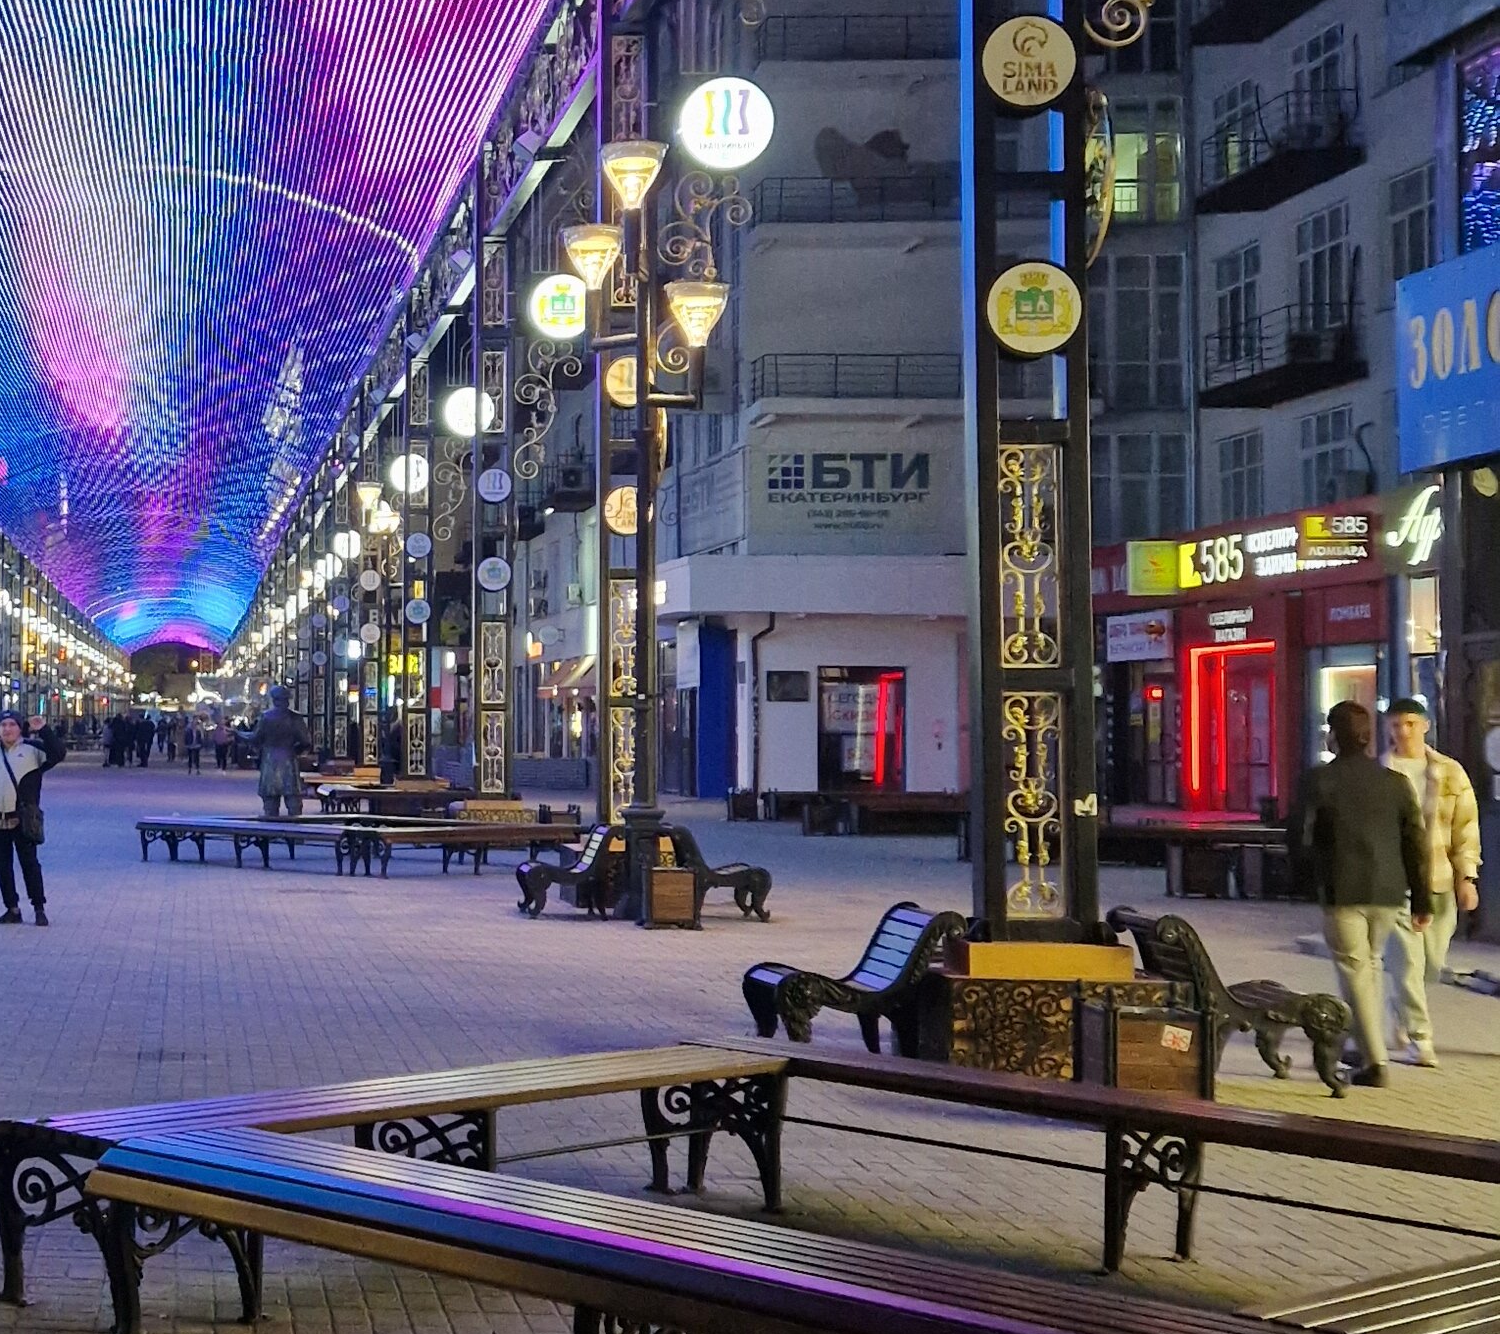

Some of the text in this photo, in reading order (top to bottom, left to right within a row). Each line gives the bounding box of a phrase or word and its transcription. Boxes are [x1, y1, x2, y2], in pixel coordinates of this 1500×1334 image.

[1003, 61, 1058, 79] SIMA
[1002, 78, 1059, 95] LAND
[811, 452, 931, 490] БТИ
[767, 491, 931, 504] ЕКАТЕРИНБУРГ
[1331, 516, 1368, 534] 585
[1201, 534, 1244, 584] 585
[1308, 545, 1368, 558] ЛОМБАРД
